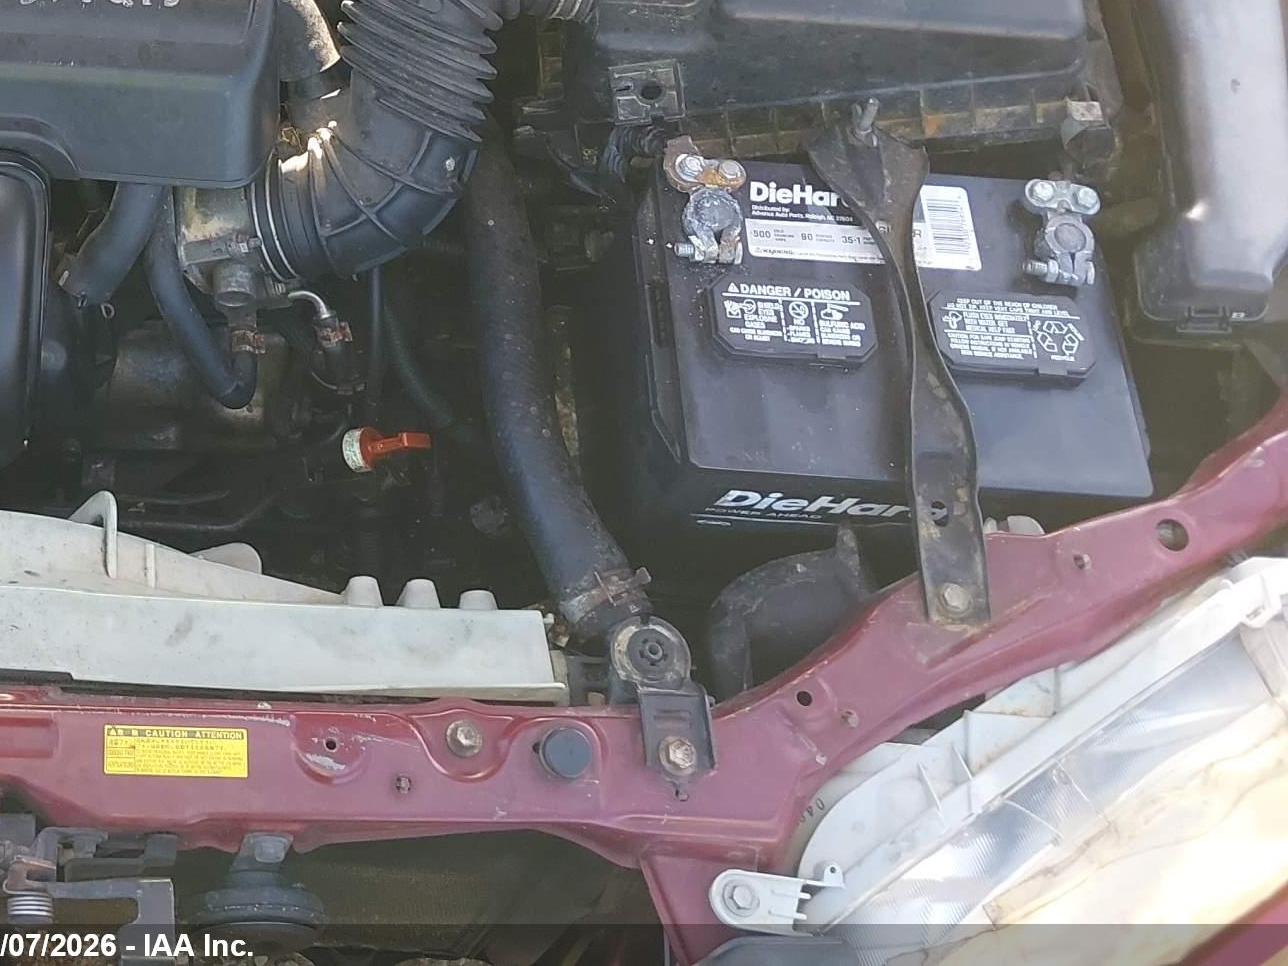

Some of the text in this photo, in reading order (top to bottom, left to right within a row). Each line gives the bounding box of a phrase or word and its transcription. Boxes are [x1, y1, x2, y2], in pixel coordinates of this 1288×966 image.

[749, 181, 849, 207] DieHar
[739, 283, 792, 297] DANGER
[804, 288, 851, 301] POISON
[145, 729, 188, 738] CAUTION
[195, 731, 243, 740] ATTENTION
